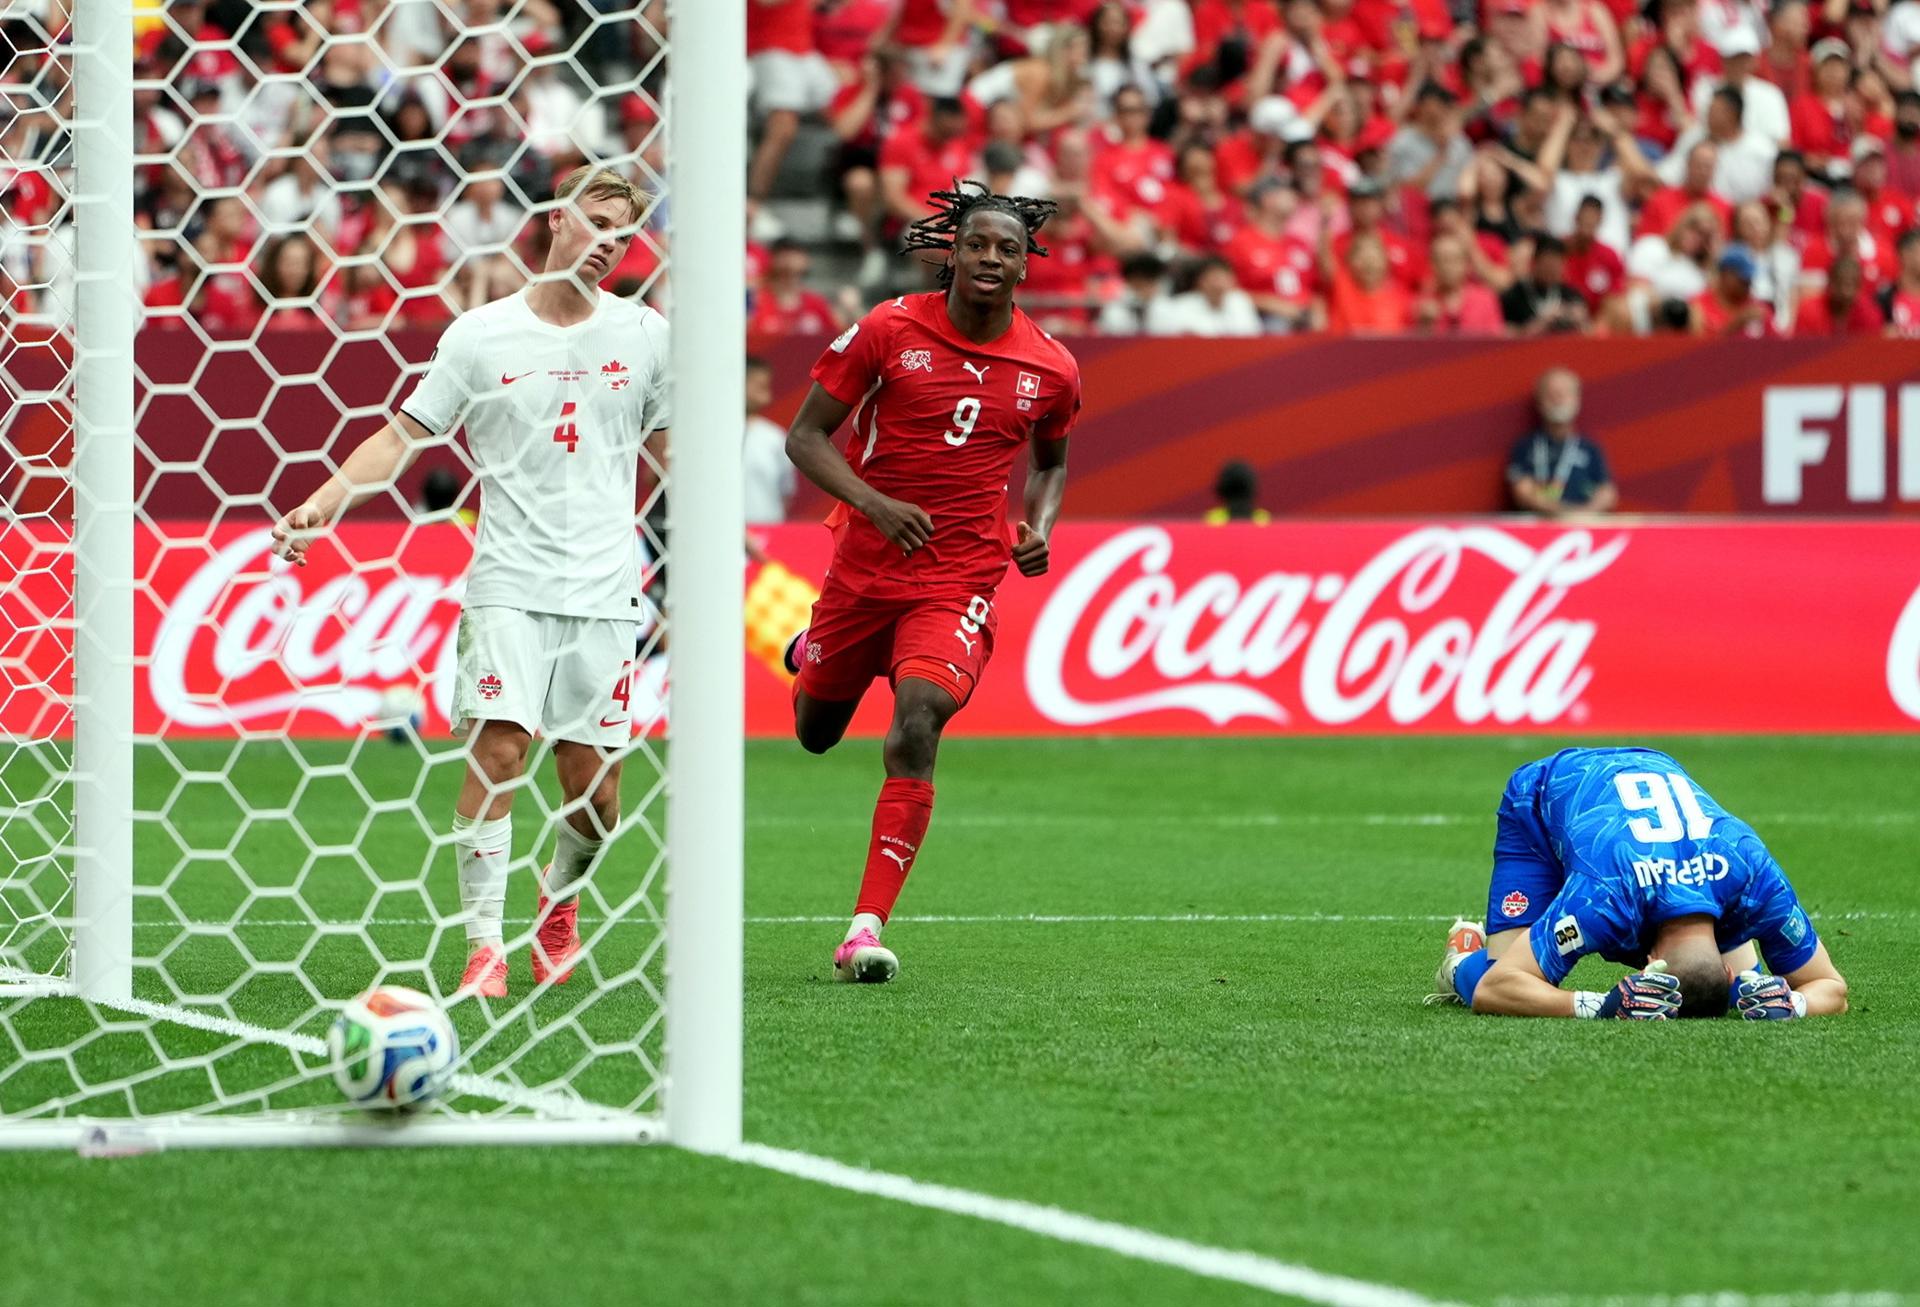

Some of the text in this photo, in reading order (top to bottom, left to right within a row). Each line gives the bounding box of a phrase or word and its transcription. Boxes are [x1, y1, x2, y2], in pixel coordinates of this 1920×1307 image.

[553, 402, 579, 453] 4
[944, 397, 981, 446] 9
[1763, 384, 1920, 503] FI
[960, 594, 989, 634] 9
[1025, 526, 1630, 726] Coca-Cola
[612, 660, 631, 712] 4
[1614, 772, 1713, 843] 16
